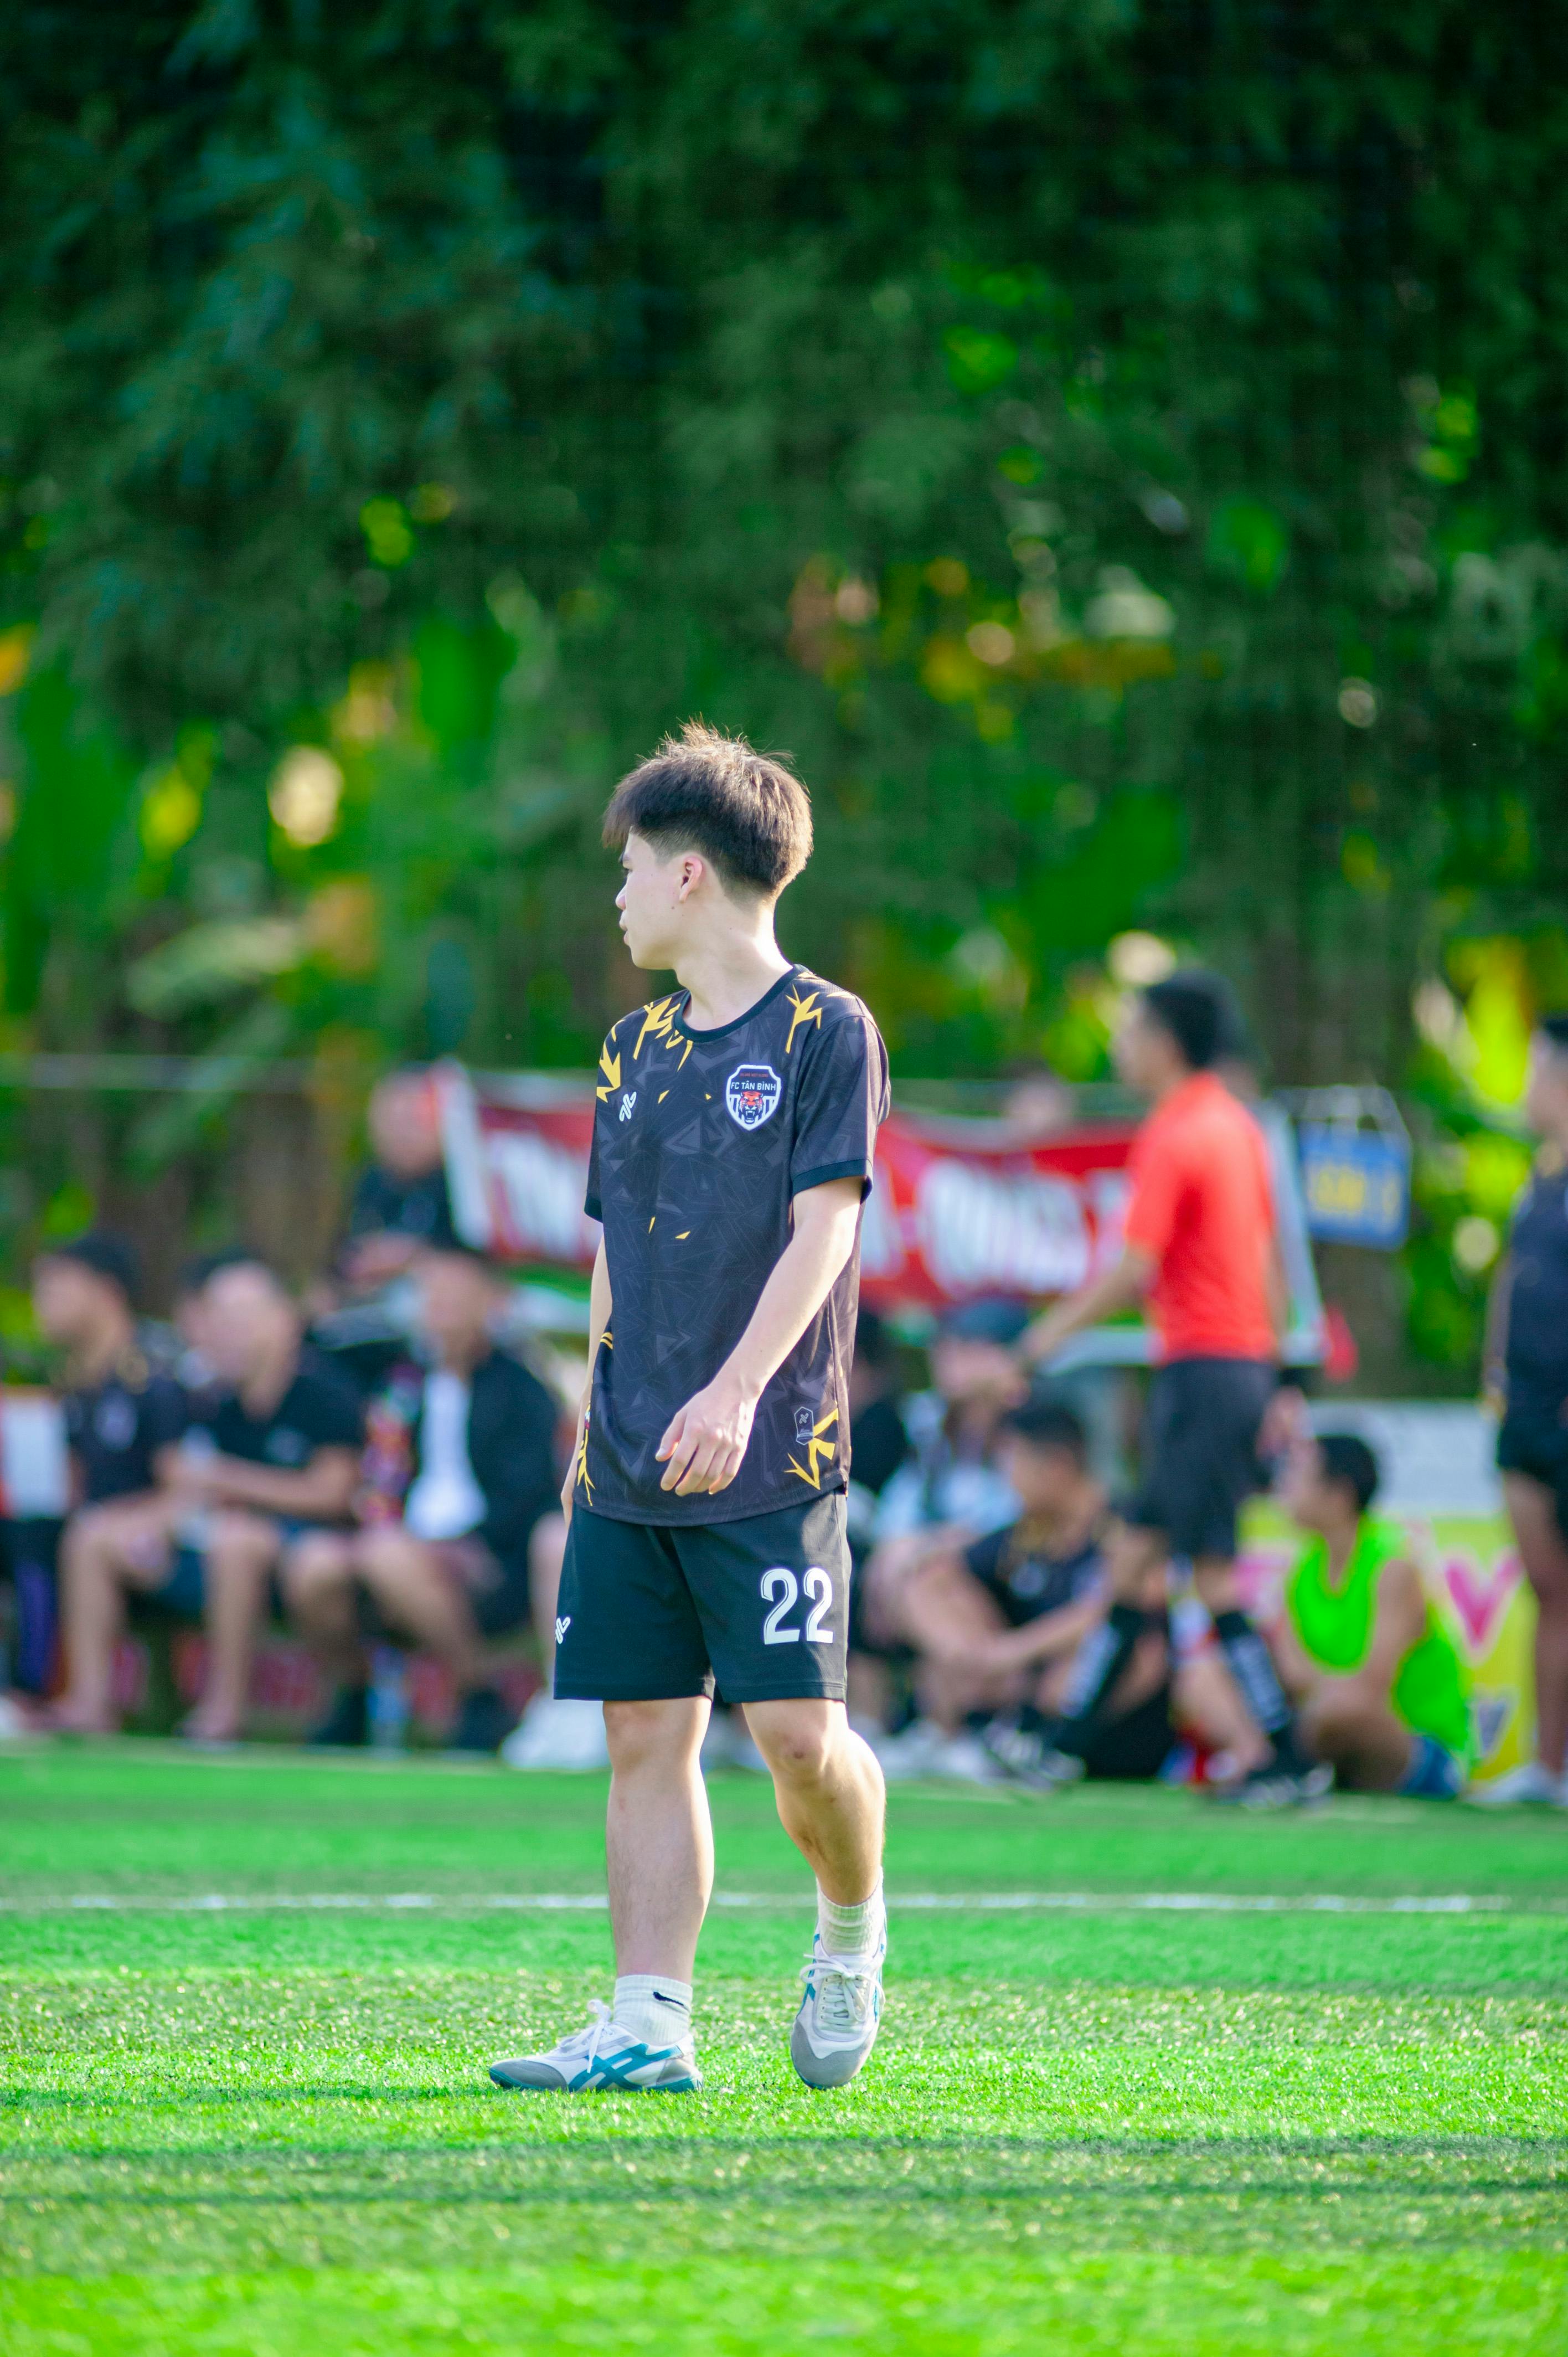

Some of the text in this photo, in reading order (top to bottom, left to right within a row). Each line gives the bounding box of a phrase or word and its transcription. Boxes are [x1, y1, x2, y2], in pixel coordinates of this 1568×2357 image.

[741, 1080, 755, 1090] TÂN
[757, 1081, 776, 1090] BÌNH
[761, 1567, 833, 1645] 22
